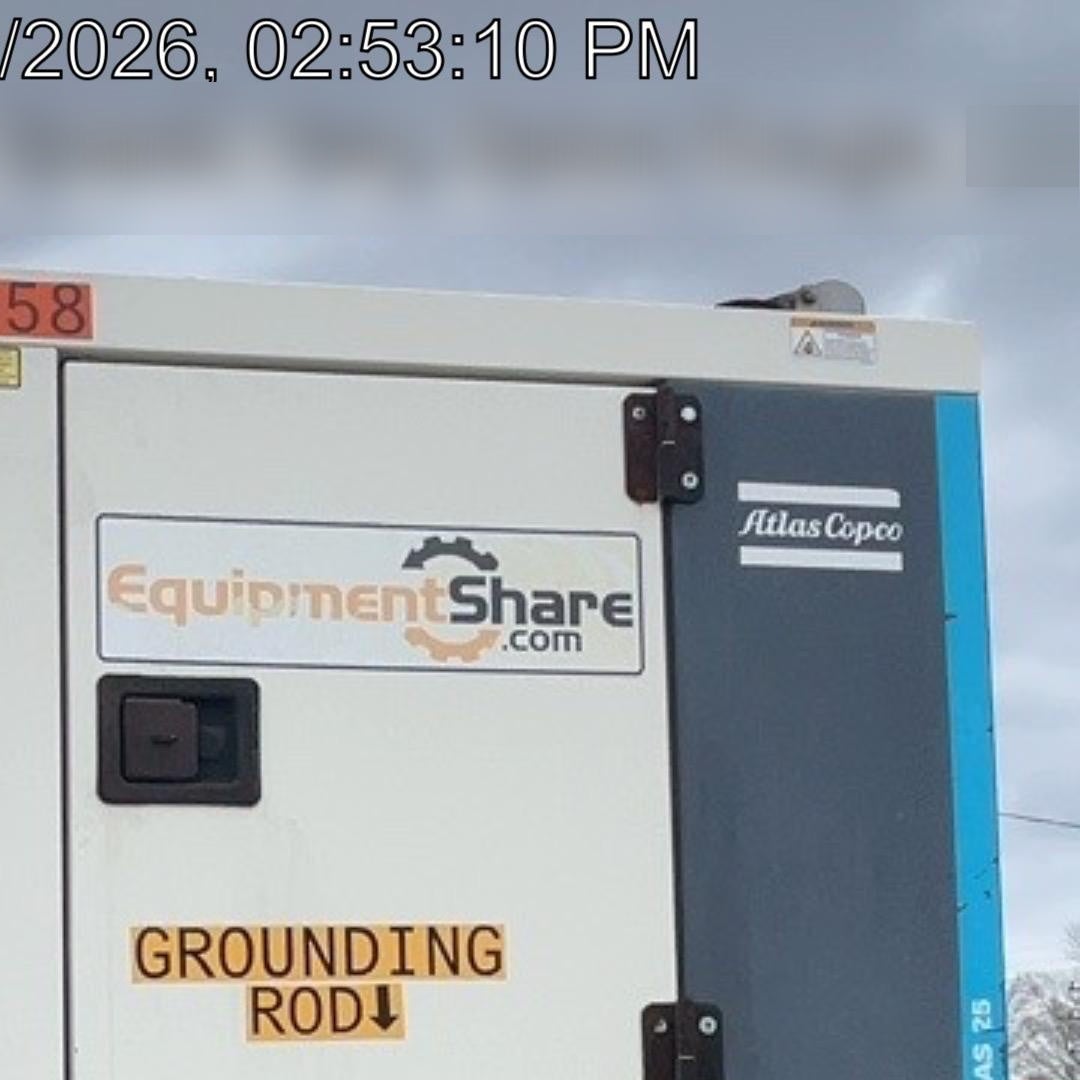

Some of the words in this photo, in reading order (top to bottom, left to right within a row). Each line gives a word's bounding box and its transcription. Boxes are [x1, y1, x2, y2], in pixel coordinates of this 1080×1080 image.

[738, 508, 821, 538] Atlas
[824, 512, 904, 546] Copco
[501, 628, 582, 652] .com
[134, 926, 504, 979] GROUNDING
[250, 986, 364, 1036] ROD
